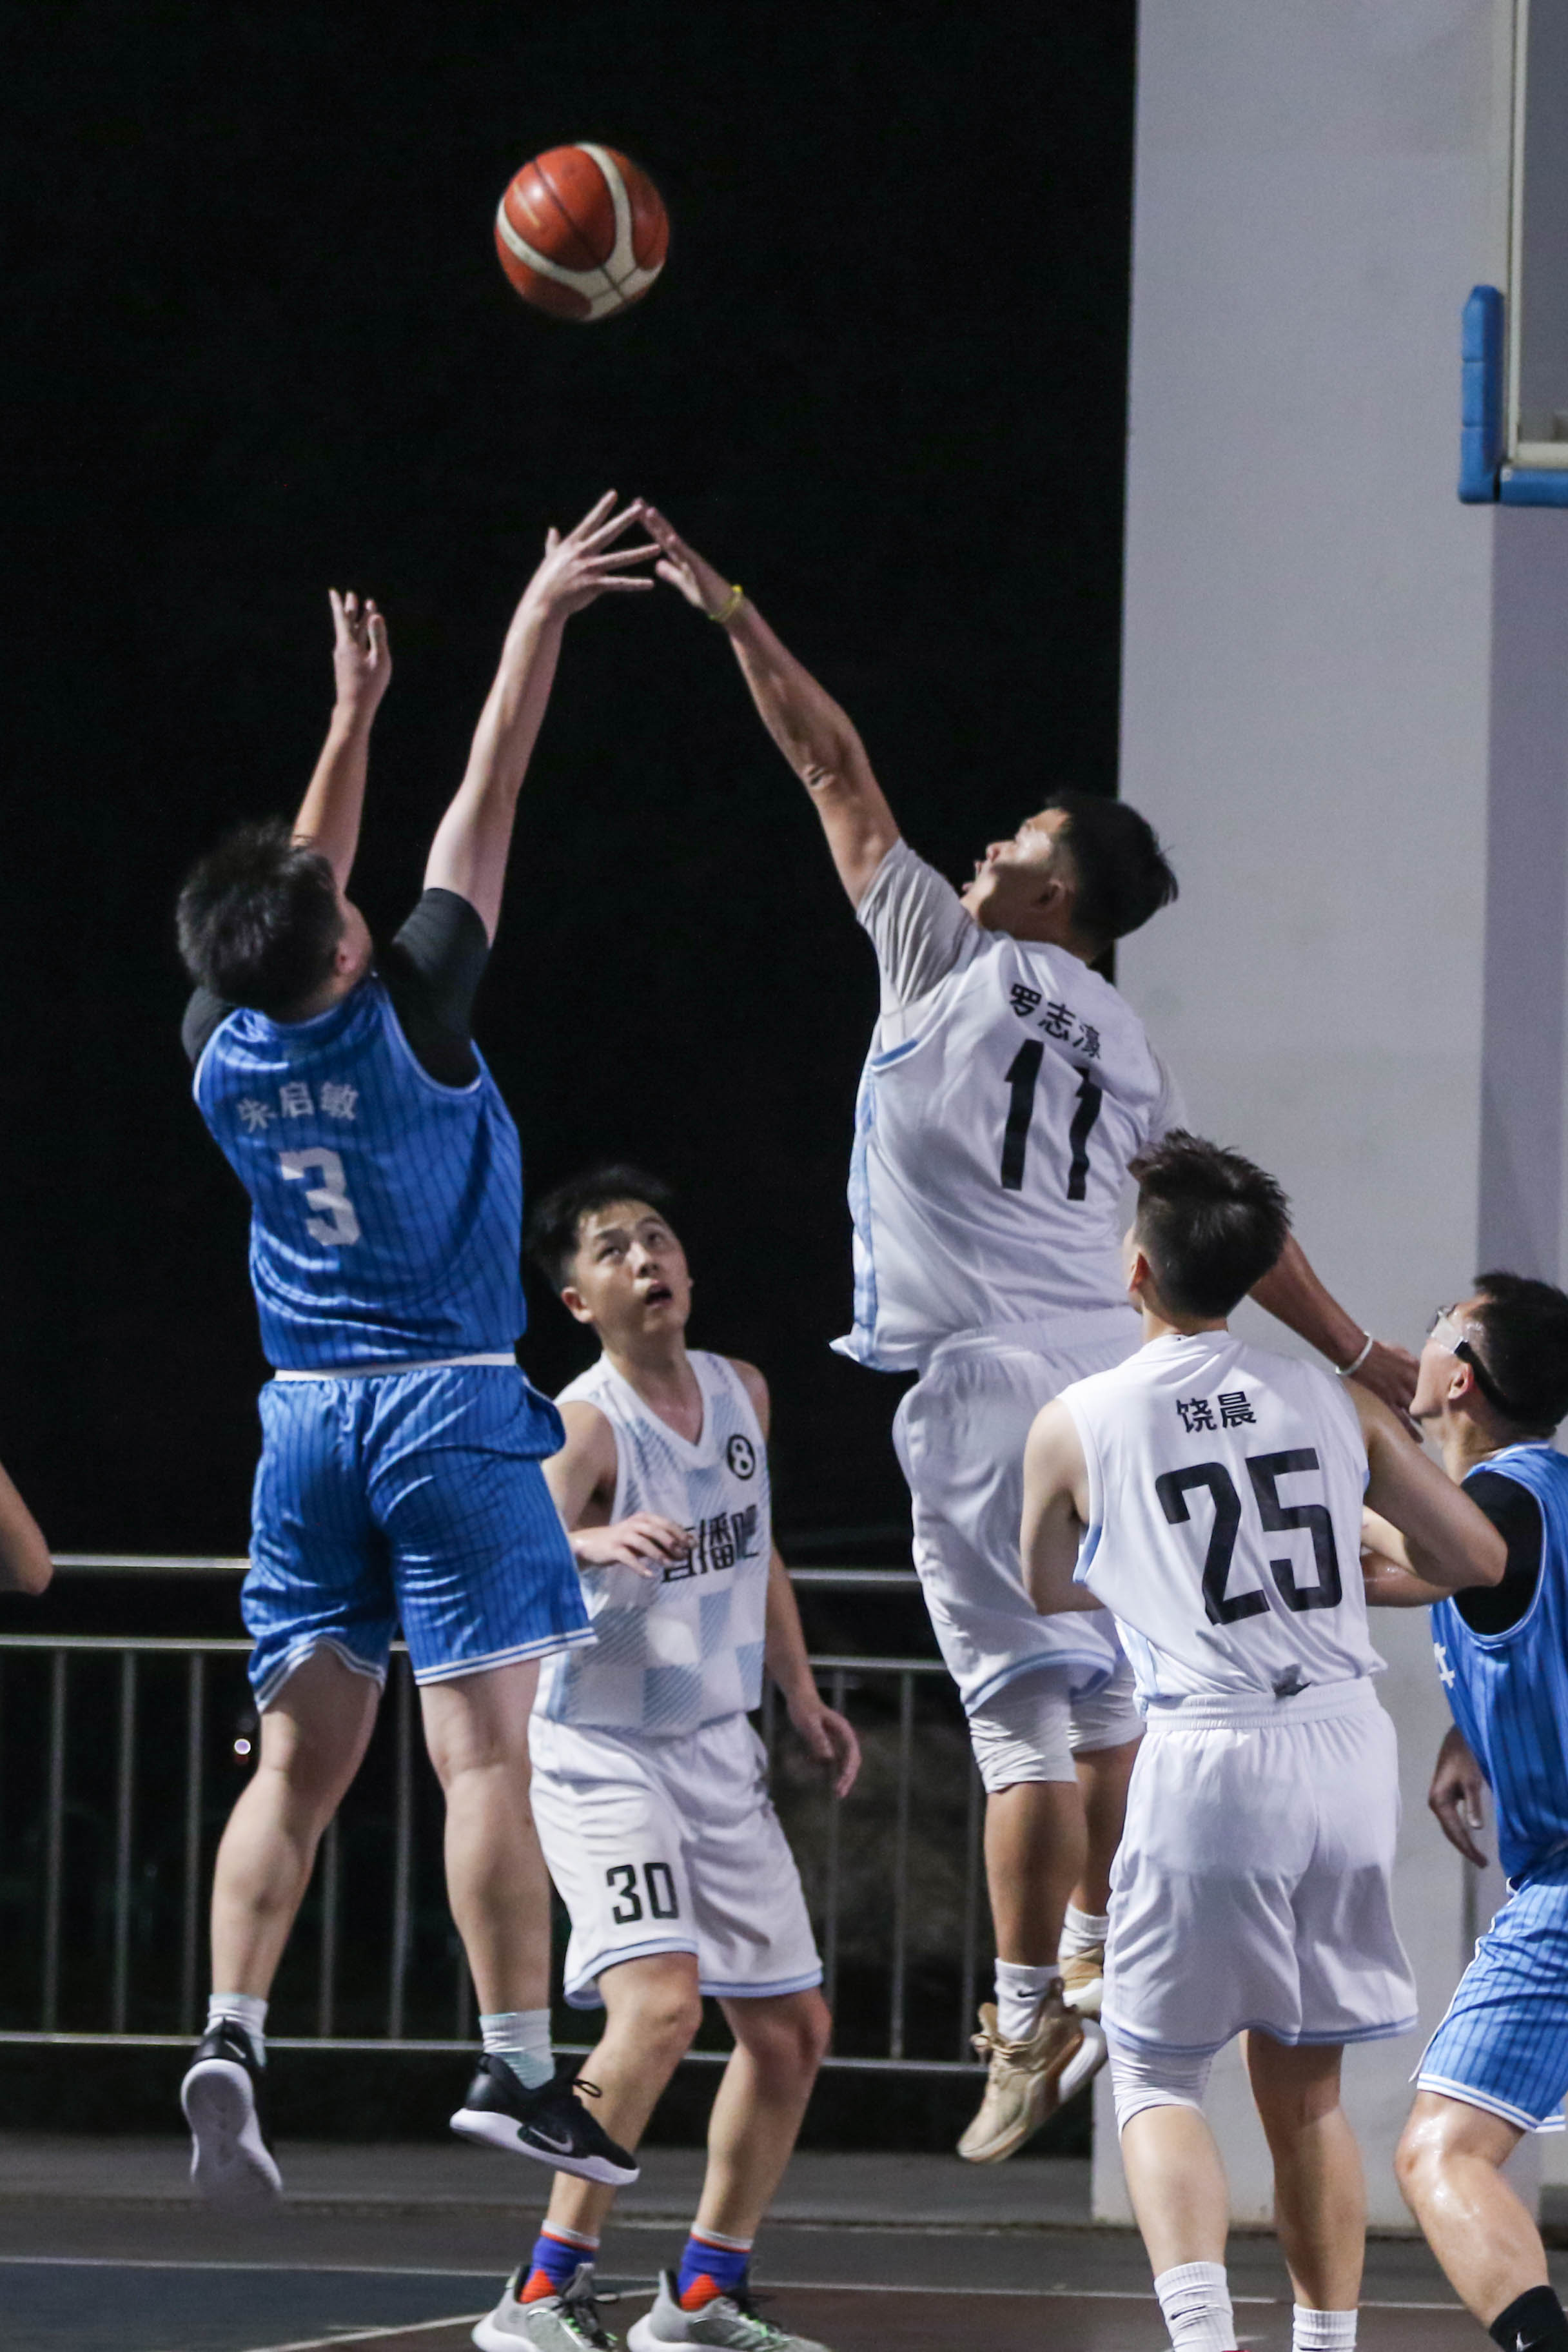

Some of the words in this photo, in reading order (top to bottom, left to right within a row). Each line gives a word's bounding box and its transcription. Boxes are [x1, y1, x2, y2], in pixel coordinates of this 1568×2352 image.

[1001, 1038, 1102, 1201] 11
[279, 1146, 361, 1246] 3
[1176, 1391, 1257, 1434] 饶晨
[1155, 1447, 1342, 1627] 25
[606, 1863, 679, 1925] 30
